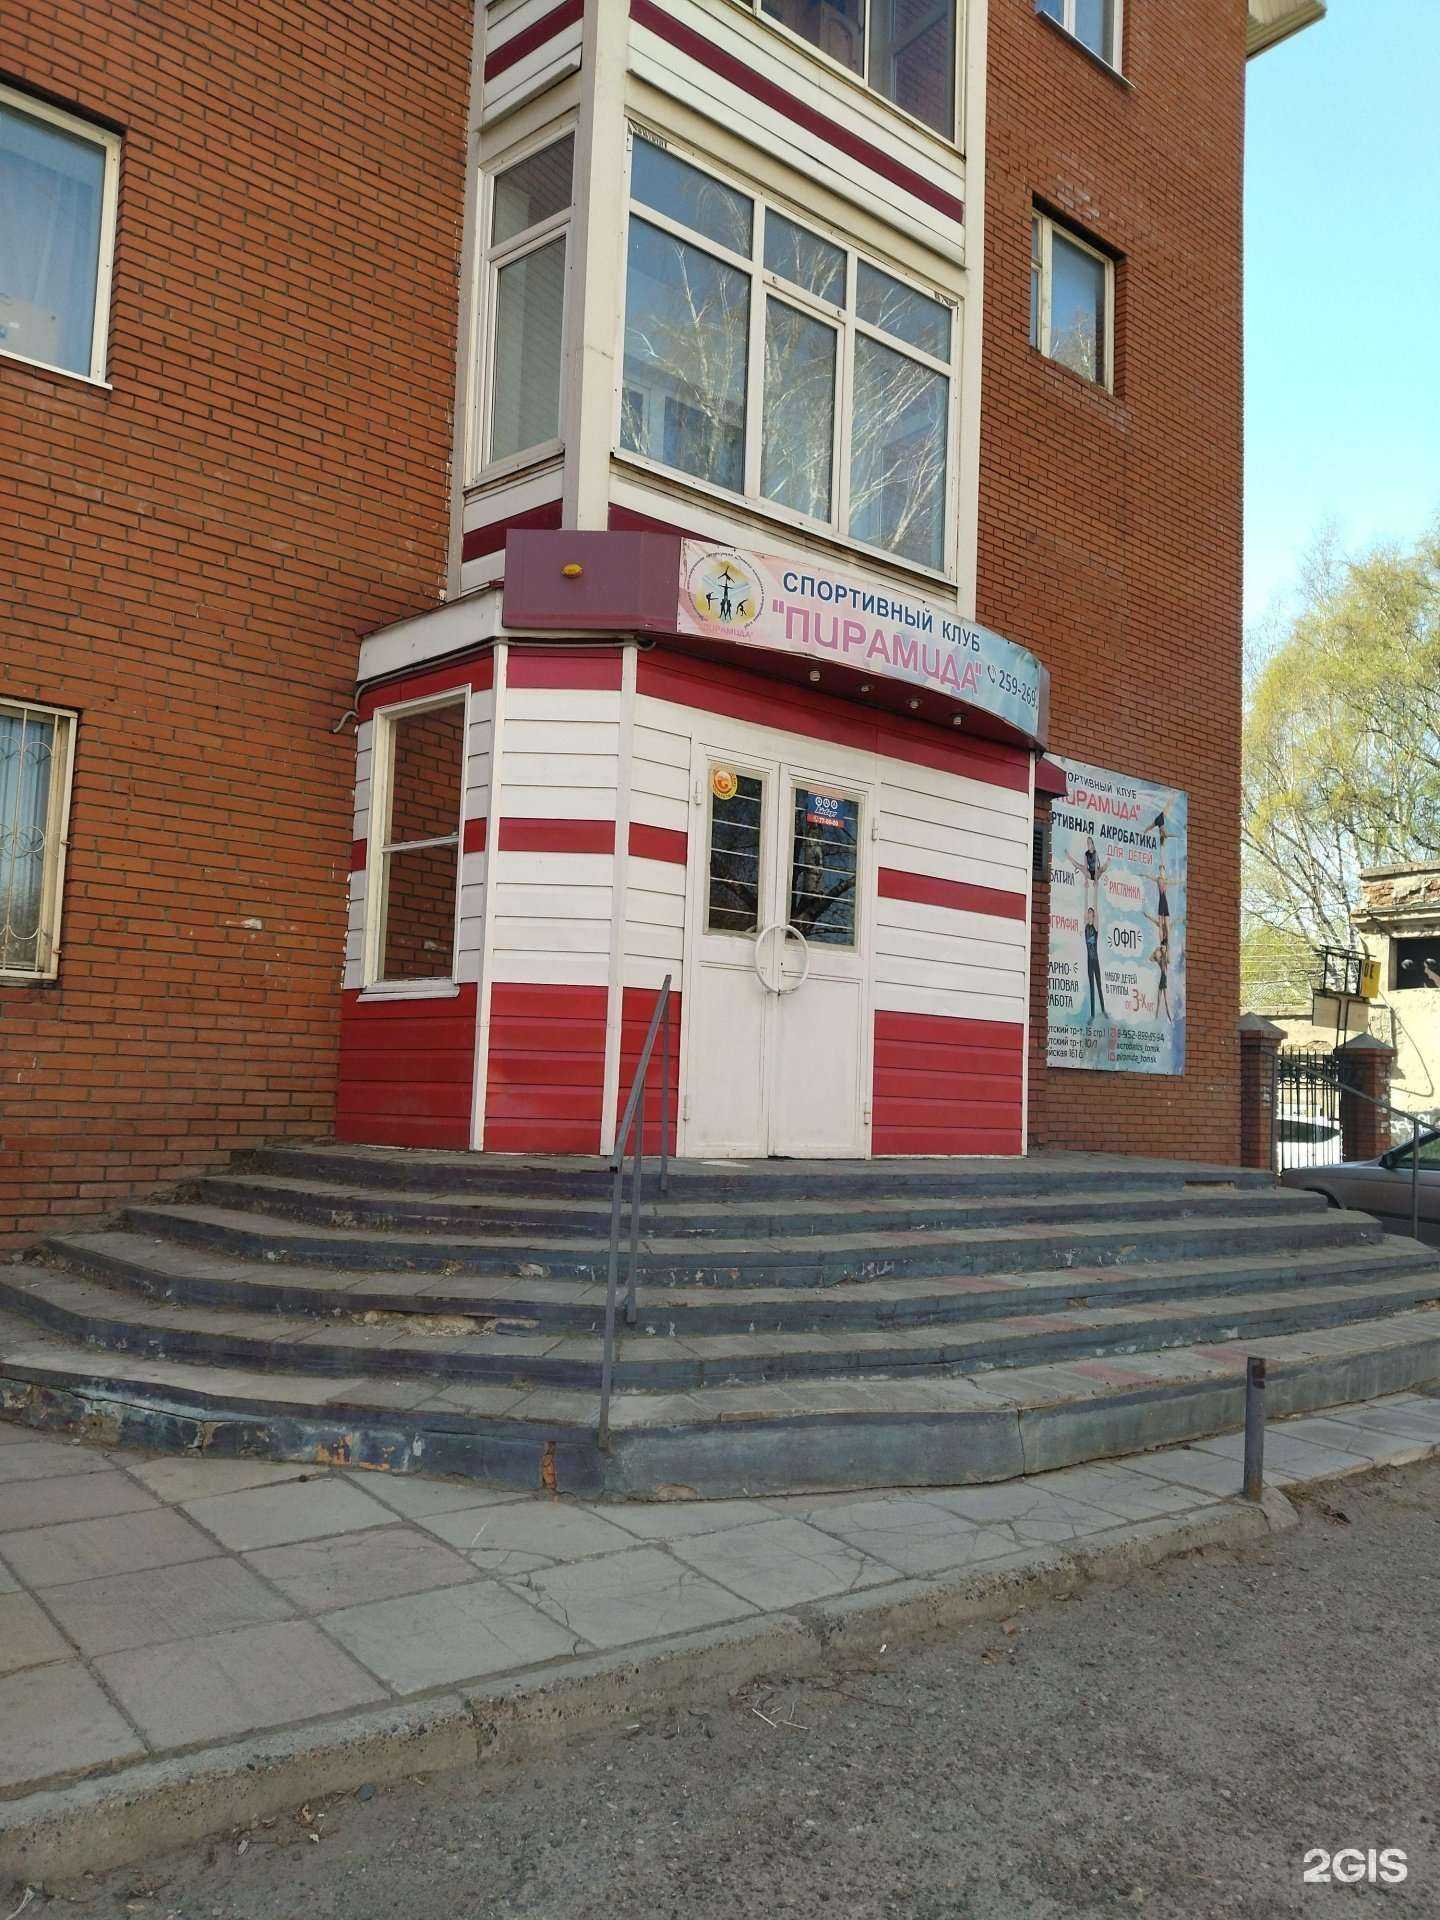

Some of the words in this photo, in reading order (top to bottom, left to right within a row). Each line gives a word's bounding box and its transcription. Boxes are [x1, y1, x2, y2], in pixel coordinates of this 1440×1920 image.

[783, 572, 933, 634] СПОРТИВНЫЙ
[942, 620, 981, 652] КЛУБ
[773, 600, 982, 694] "ПИРАМИДА"
[999, 669, 1038, 710] 259-269
[1067, 772, 1113, 793] ОРТИВНЫЙ
[1116, 786, 1137, 800] КЛУБ
[1051, 811, 1095, 836] РТИВНАЯ
[1100, 823, 1157, 850] АКРОБАТИКА
[1128, 849, 1153, 865] ДЕТЕЙ
[1050, 868, 1075, 887] БАТИКА
[1050, 914, 1078, 932] ГРАФИЯ
[1113, 927, 1137, 949] ОФП
[1049, 961, 1072, 975] АРНО-
[1049, 977, 1079, 992] ППОВАЯ
[1048, 994, 1074, 1008] АБОТА
